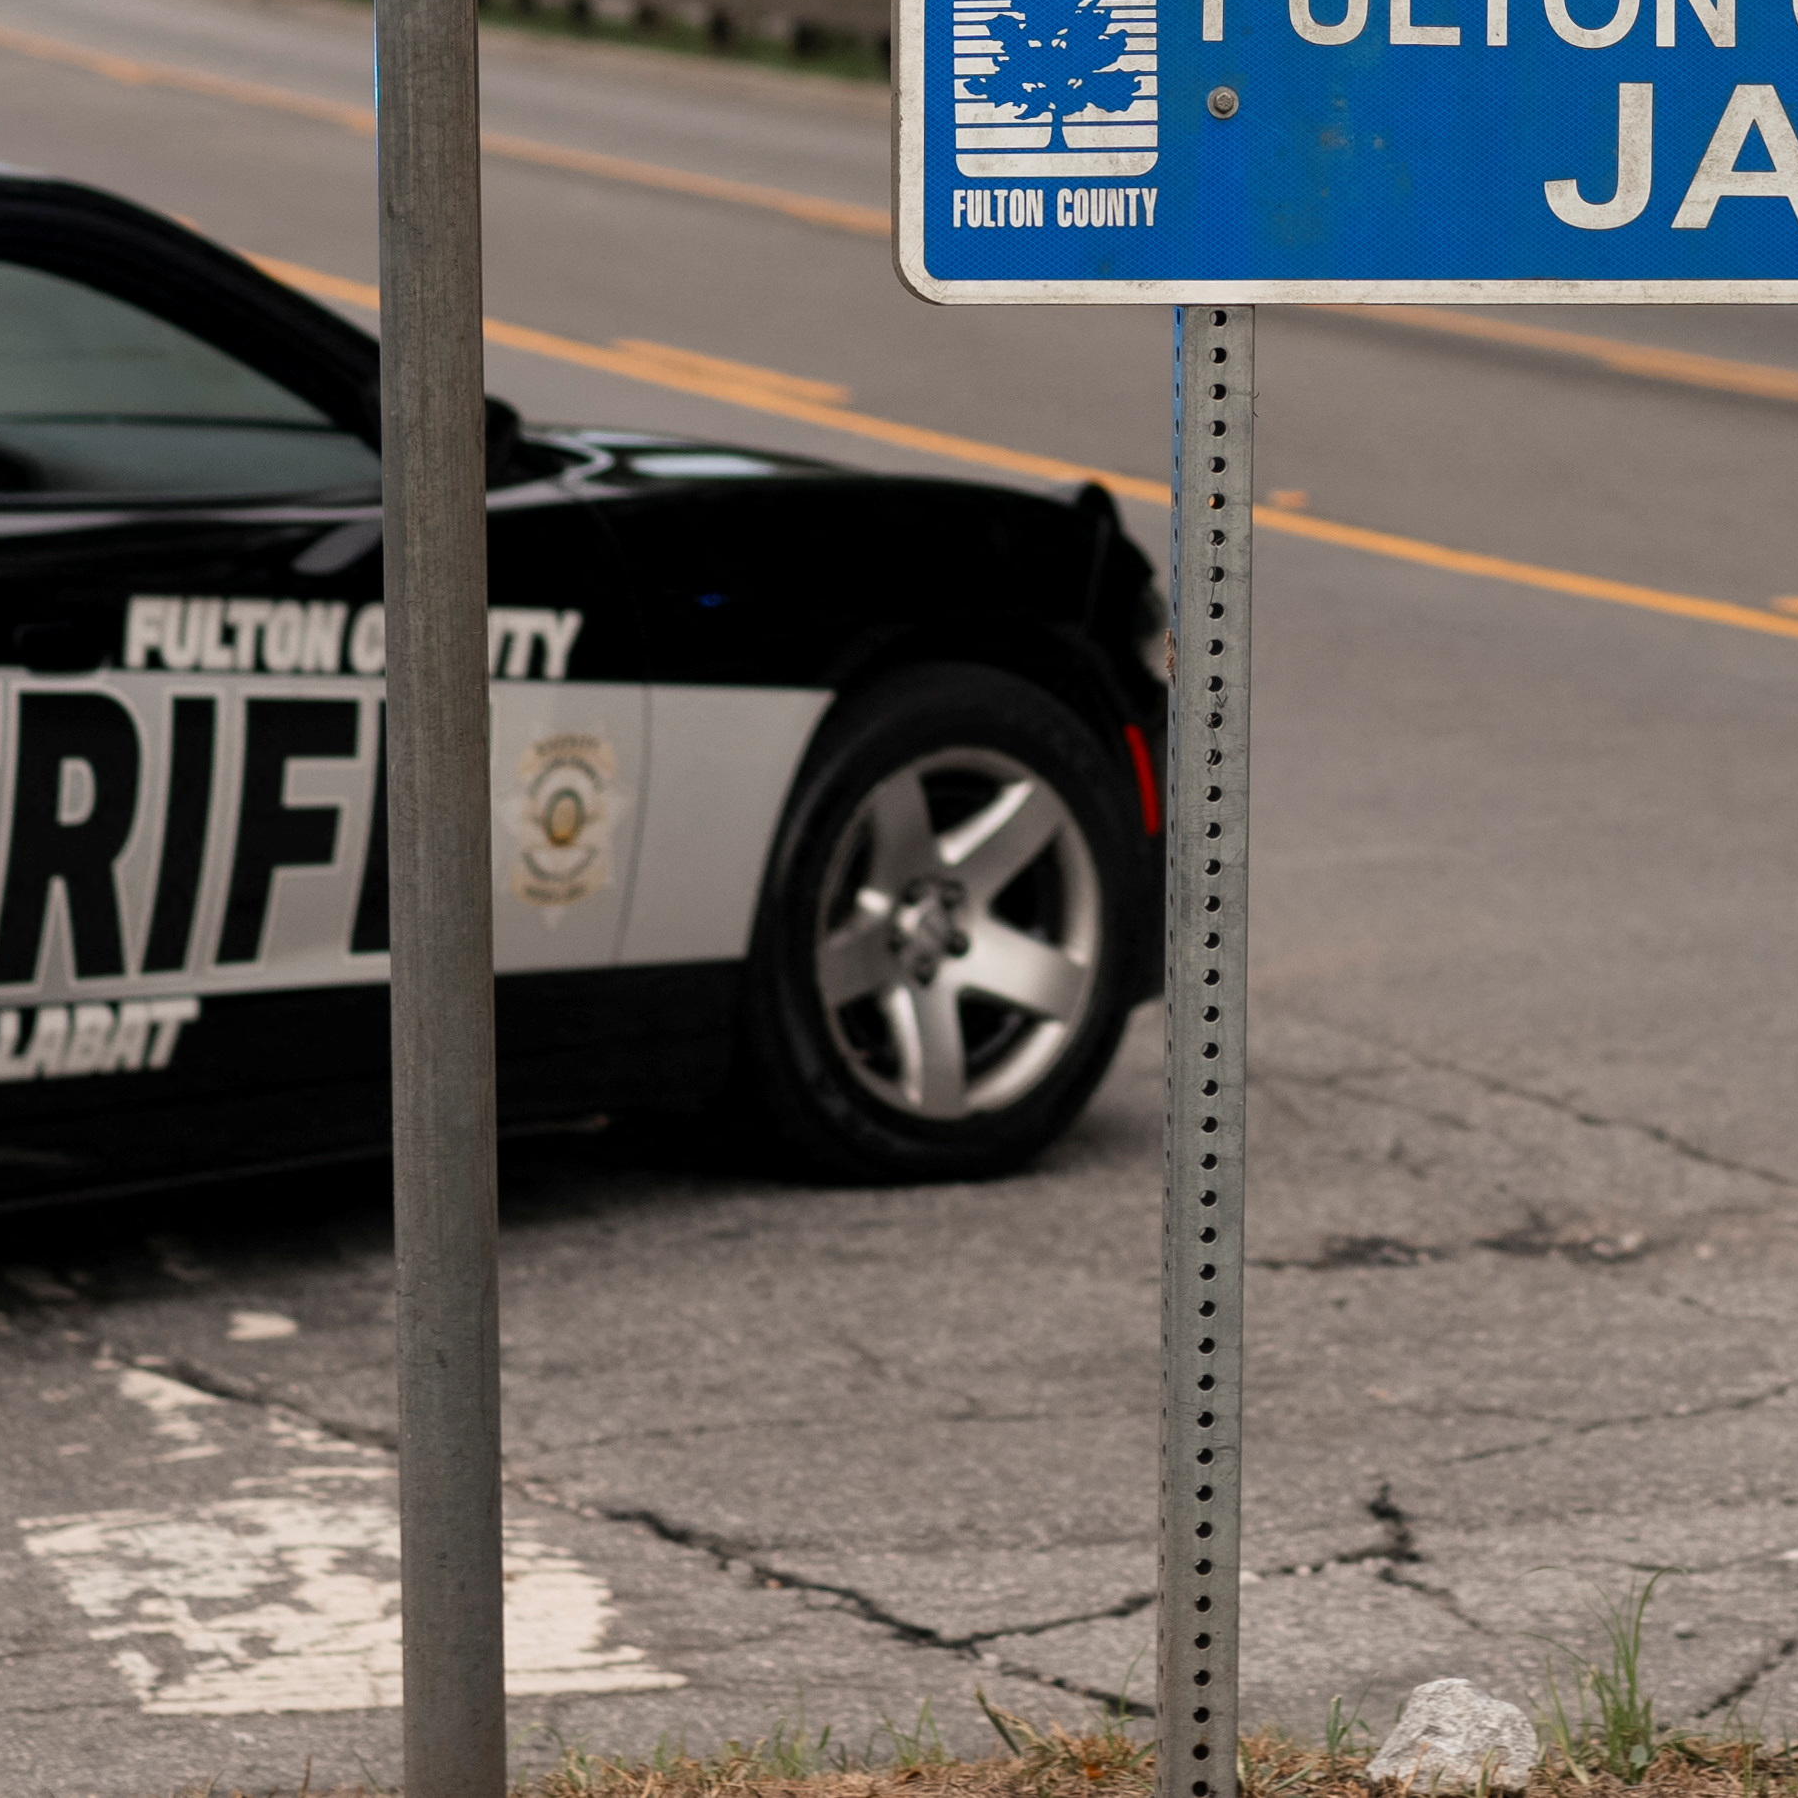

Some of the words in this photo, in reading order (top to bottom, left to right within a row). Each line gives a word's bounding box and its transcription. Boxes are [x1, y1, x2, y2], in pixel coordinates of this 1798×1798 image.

[952, 187, 1044, 229] FULTON
[1056, 186, 1158, 228] COUNTY
[124, 595, 349, 674] FULTON
[348, 600, 583, 680] CTY
